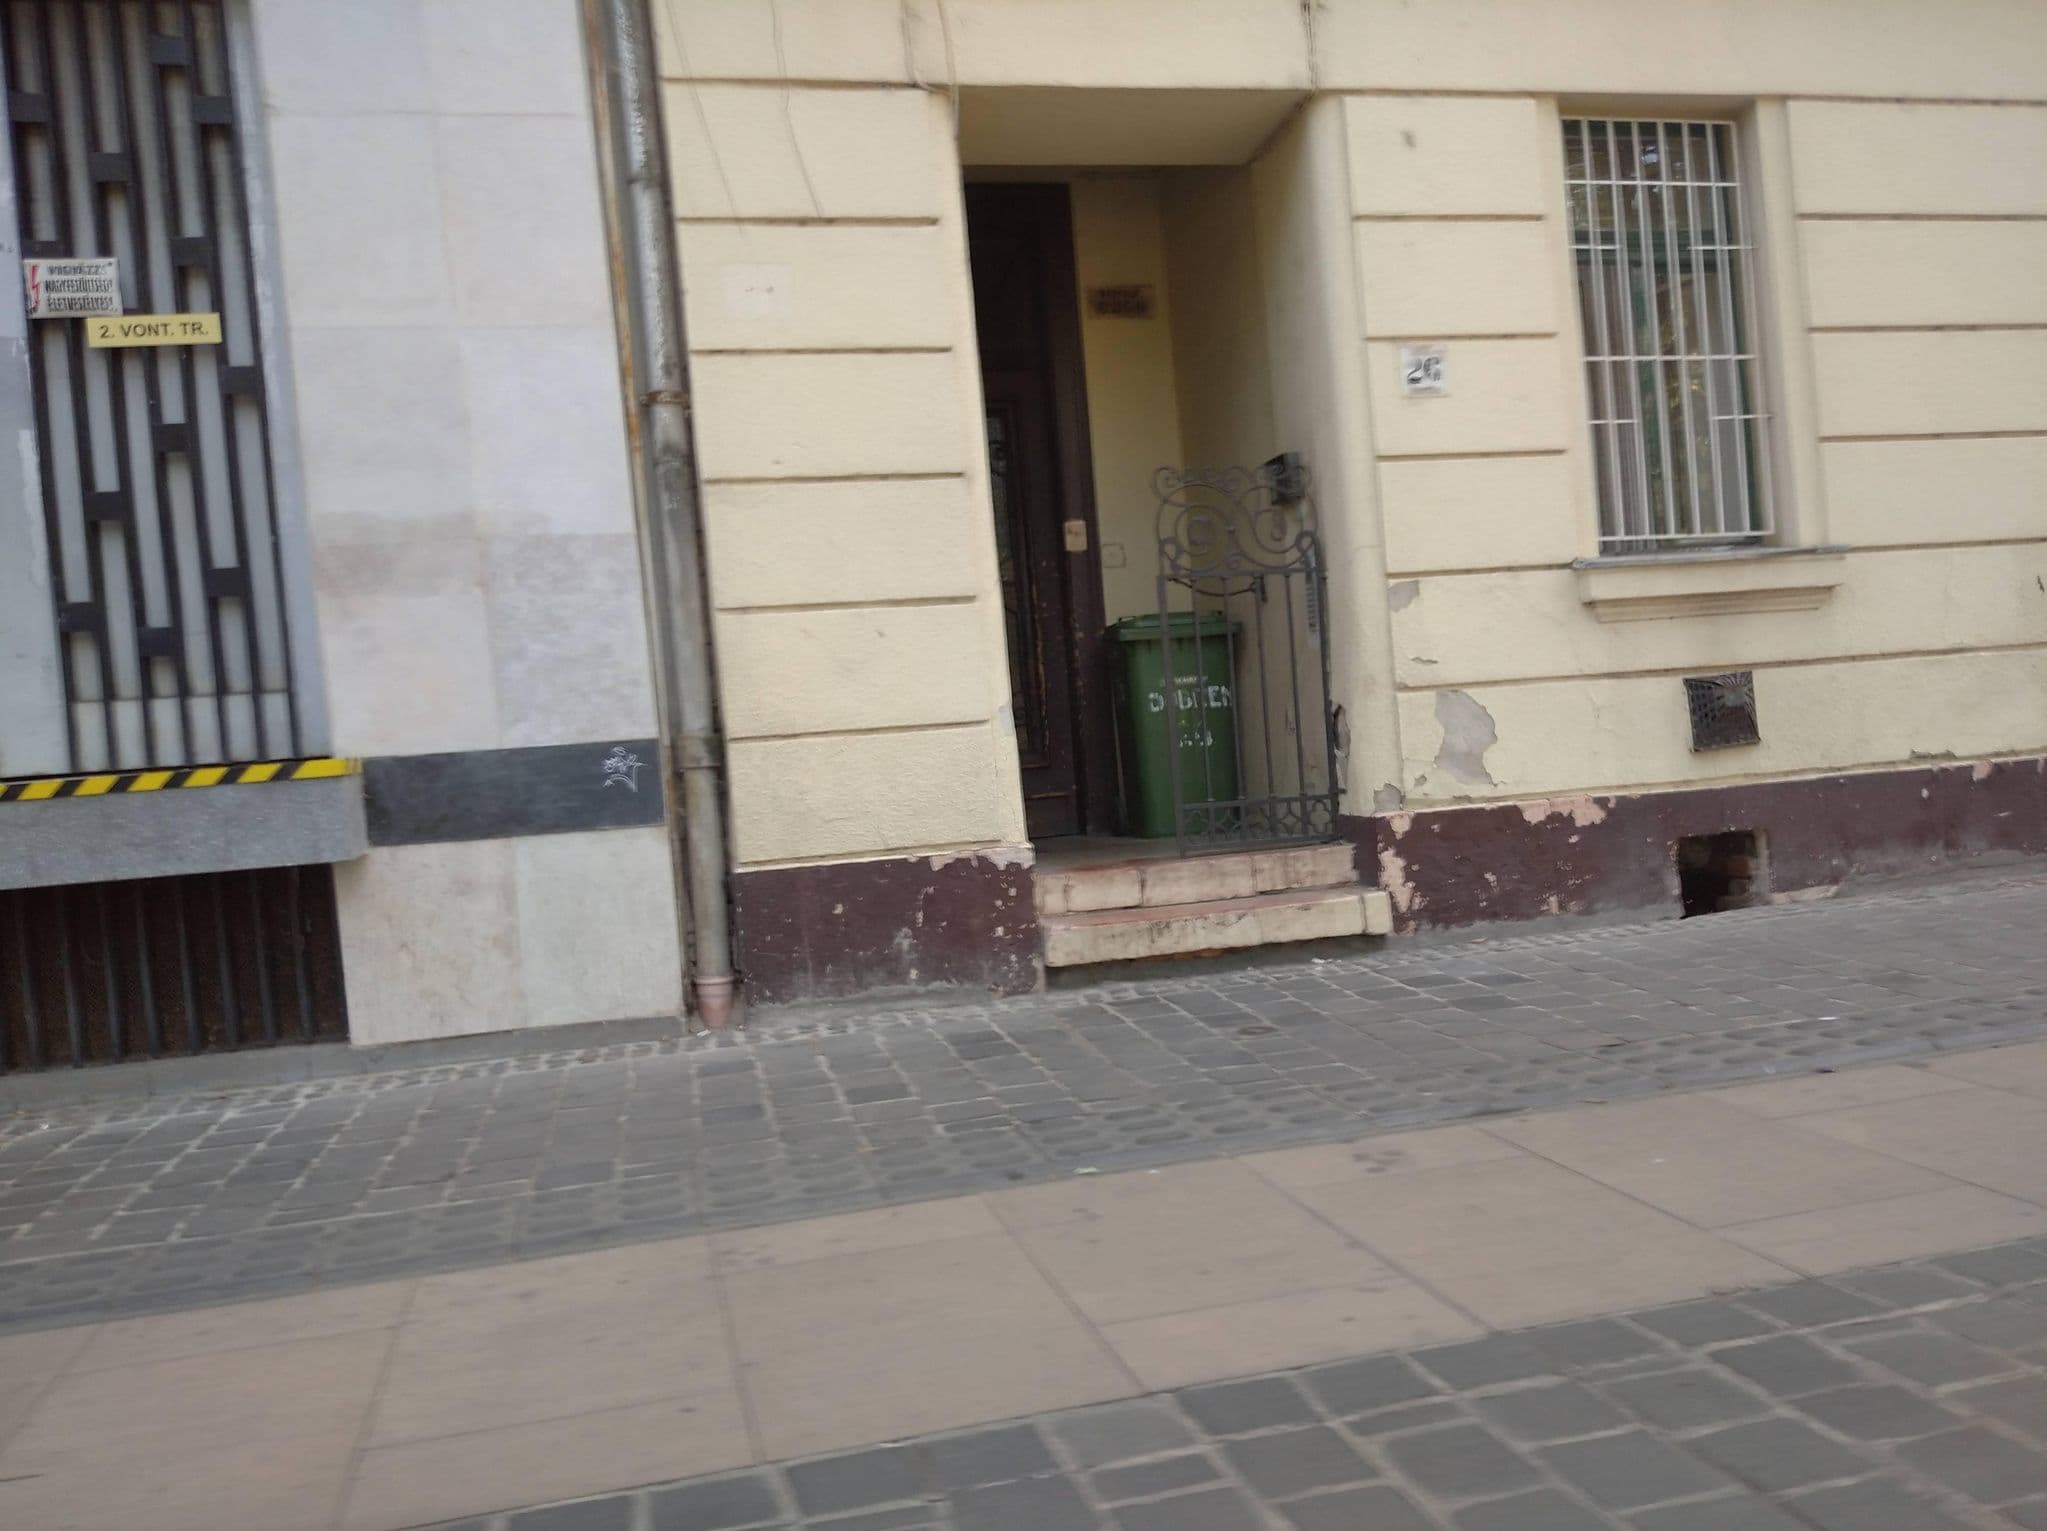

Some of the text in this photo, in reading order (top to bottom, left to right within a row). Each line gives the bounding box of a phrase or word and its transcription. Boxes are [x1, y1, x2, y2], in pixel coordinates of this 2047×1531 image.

[98, 321, 211, 340] 2. VONT. TR.
